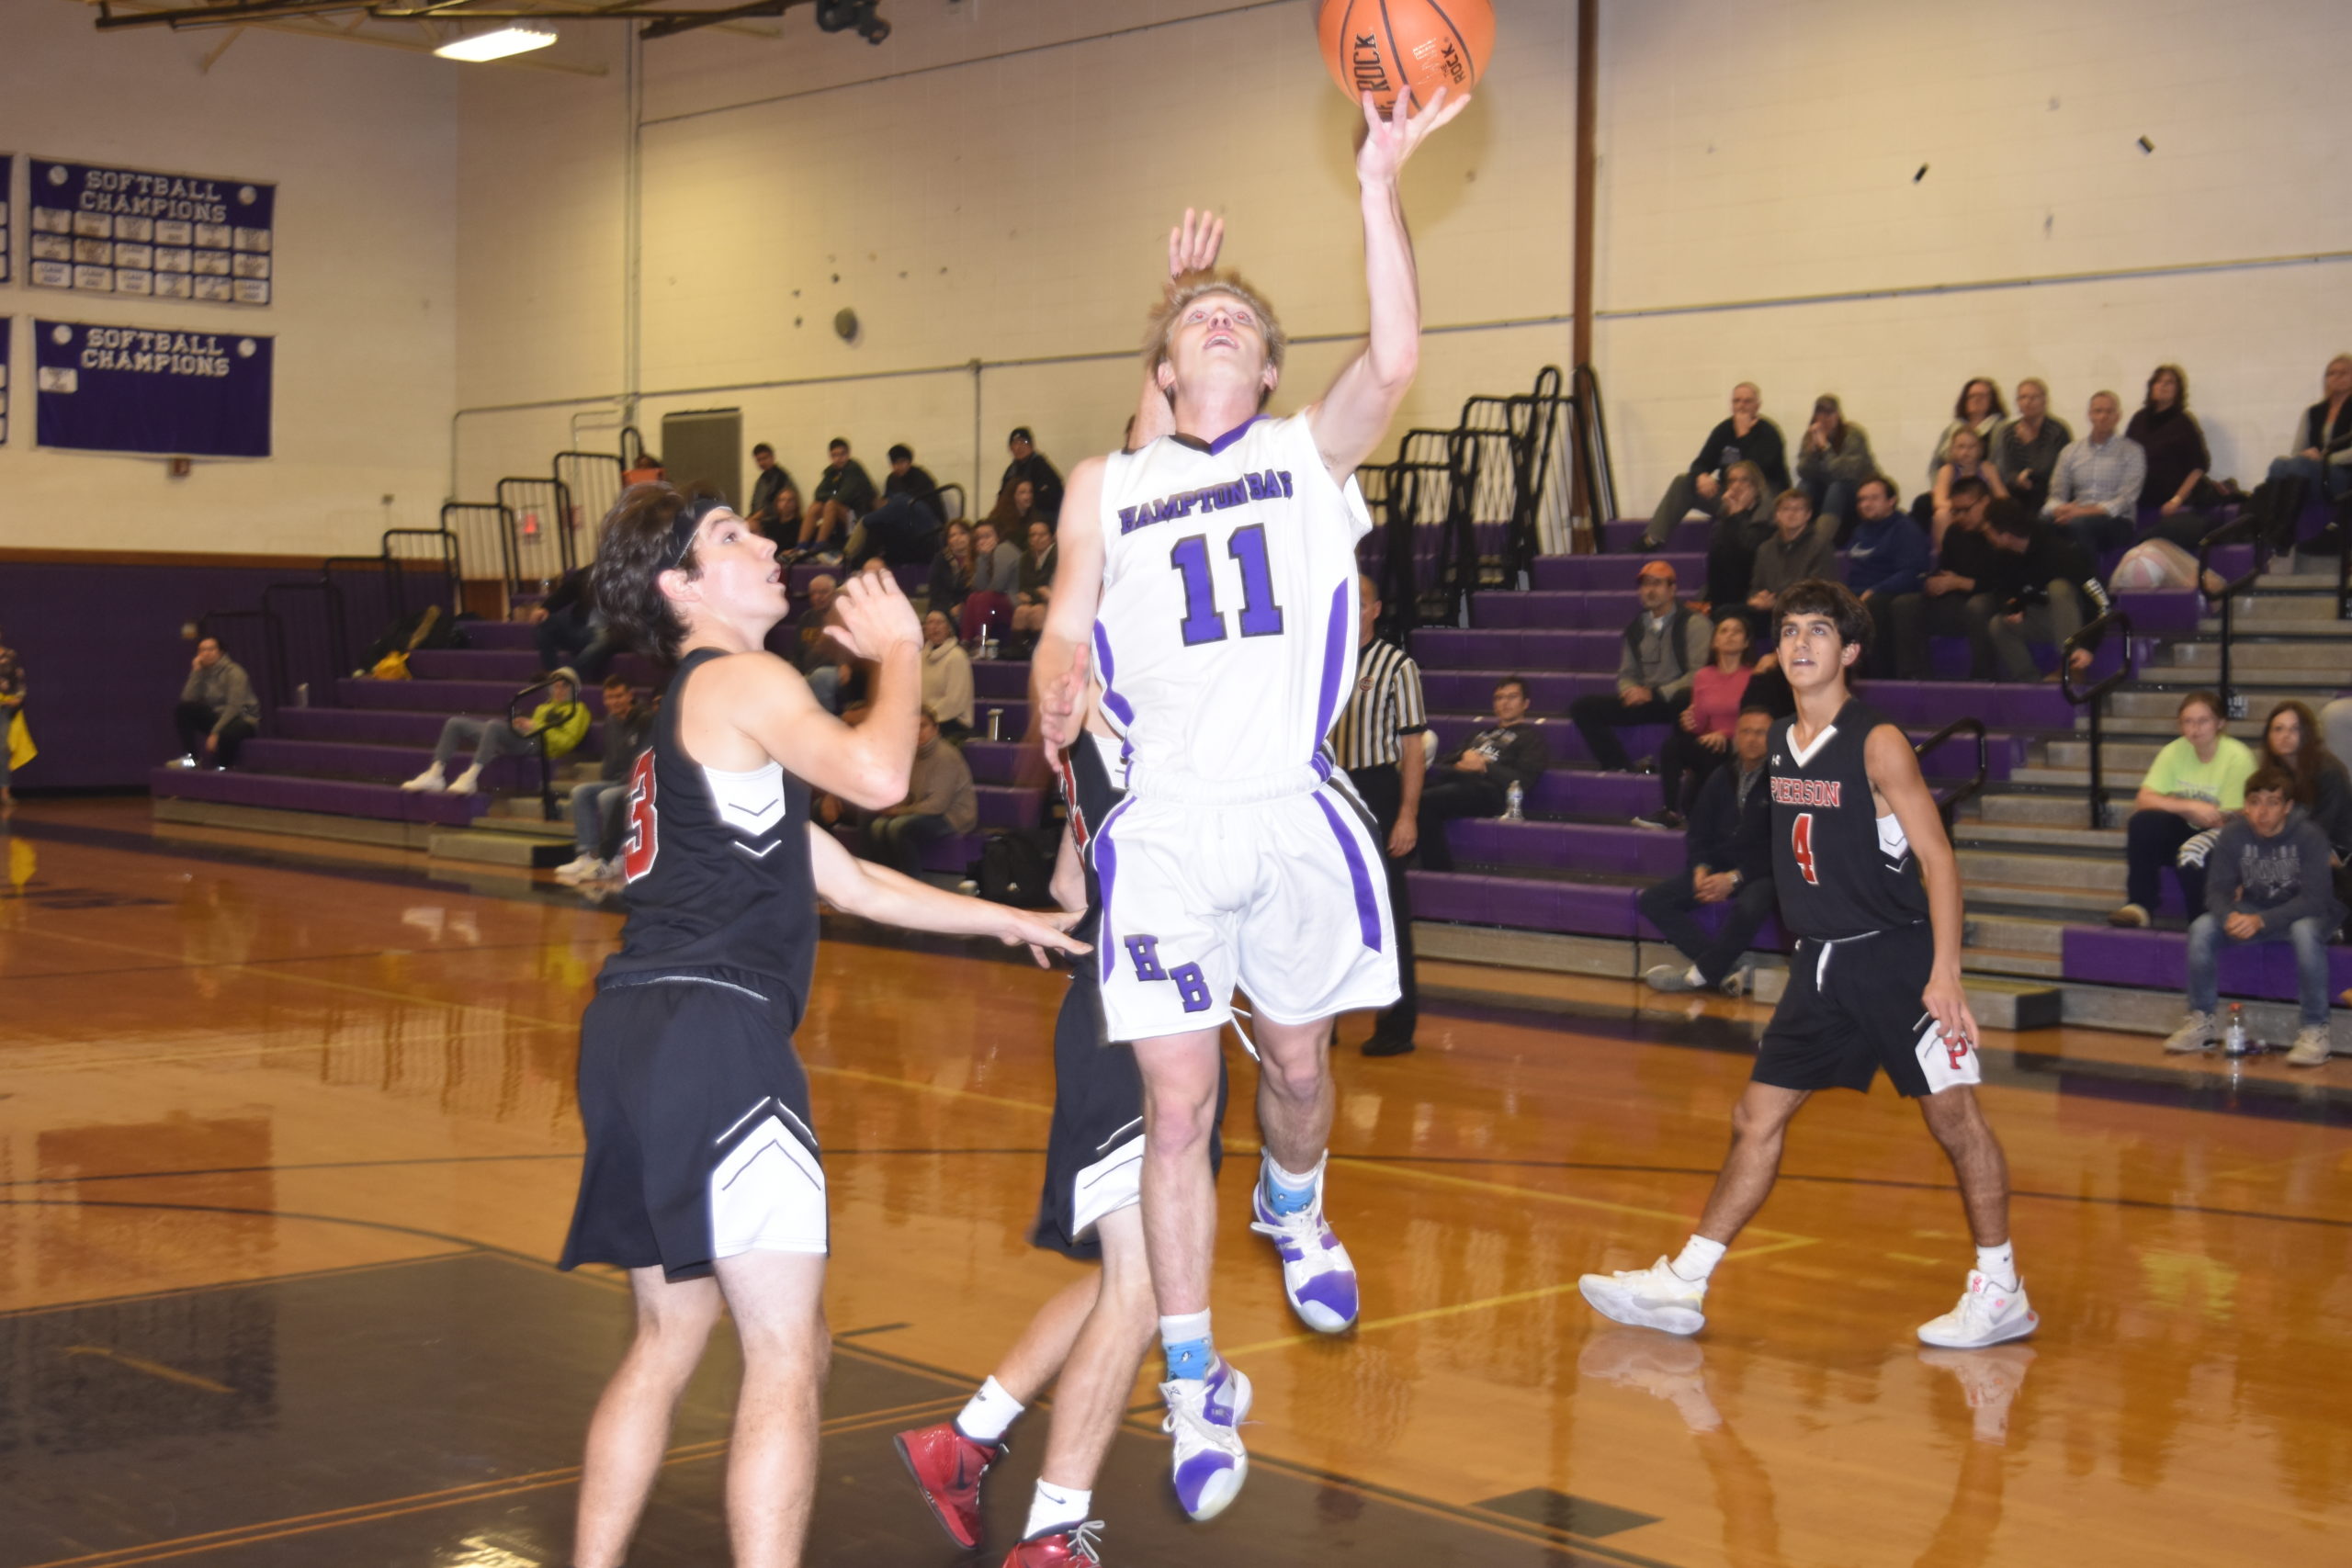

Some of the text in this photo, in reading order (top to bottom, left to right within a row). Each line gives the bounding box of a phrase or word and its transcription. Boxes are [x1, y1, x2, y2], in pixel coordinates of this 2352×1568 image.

[1353, 33, 1391, 92] ROCK
[1441, 42, 1466, 85] ROCK
[85, 169, 221, 202] SOFTBALL
[79, 190, 228, 223] CHAMPIONS
[86, 327, 224, 356] SOFTBALL
[81, 348, 230, 378] CHAMPIONS
[1117, 476, 1249, 536] HAMPTON
[1170, 522, 1284, 648] 11
[1770, 776, 1841, 807] PIERSON
[625, 746, 659, 884] 3
[1792, 812, 1820, 886] 4
[1942, 1035, 1968, 1070] P
